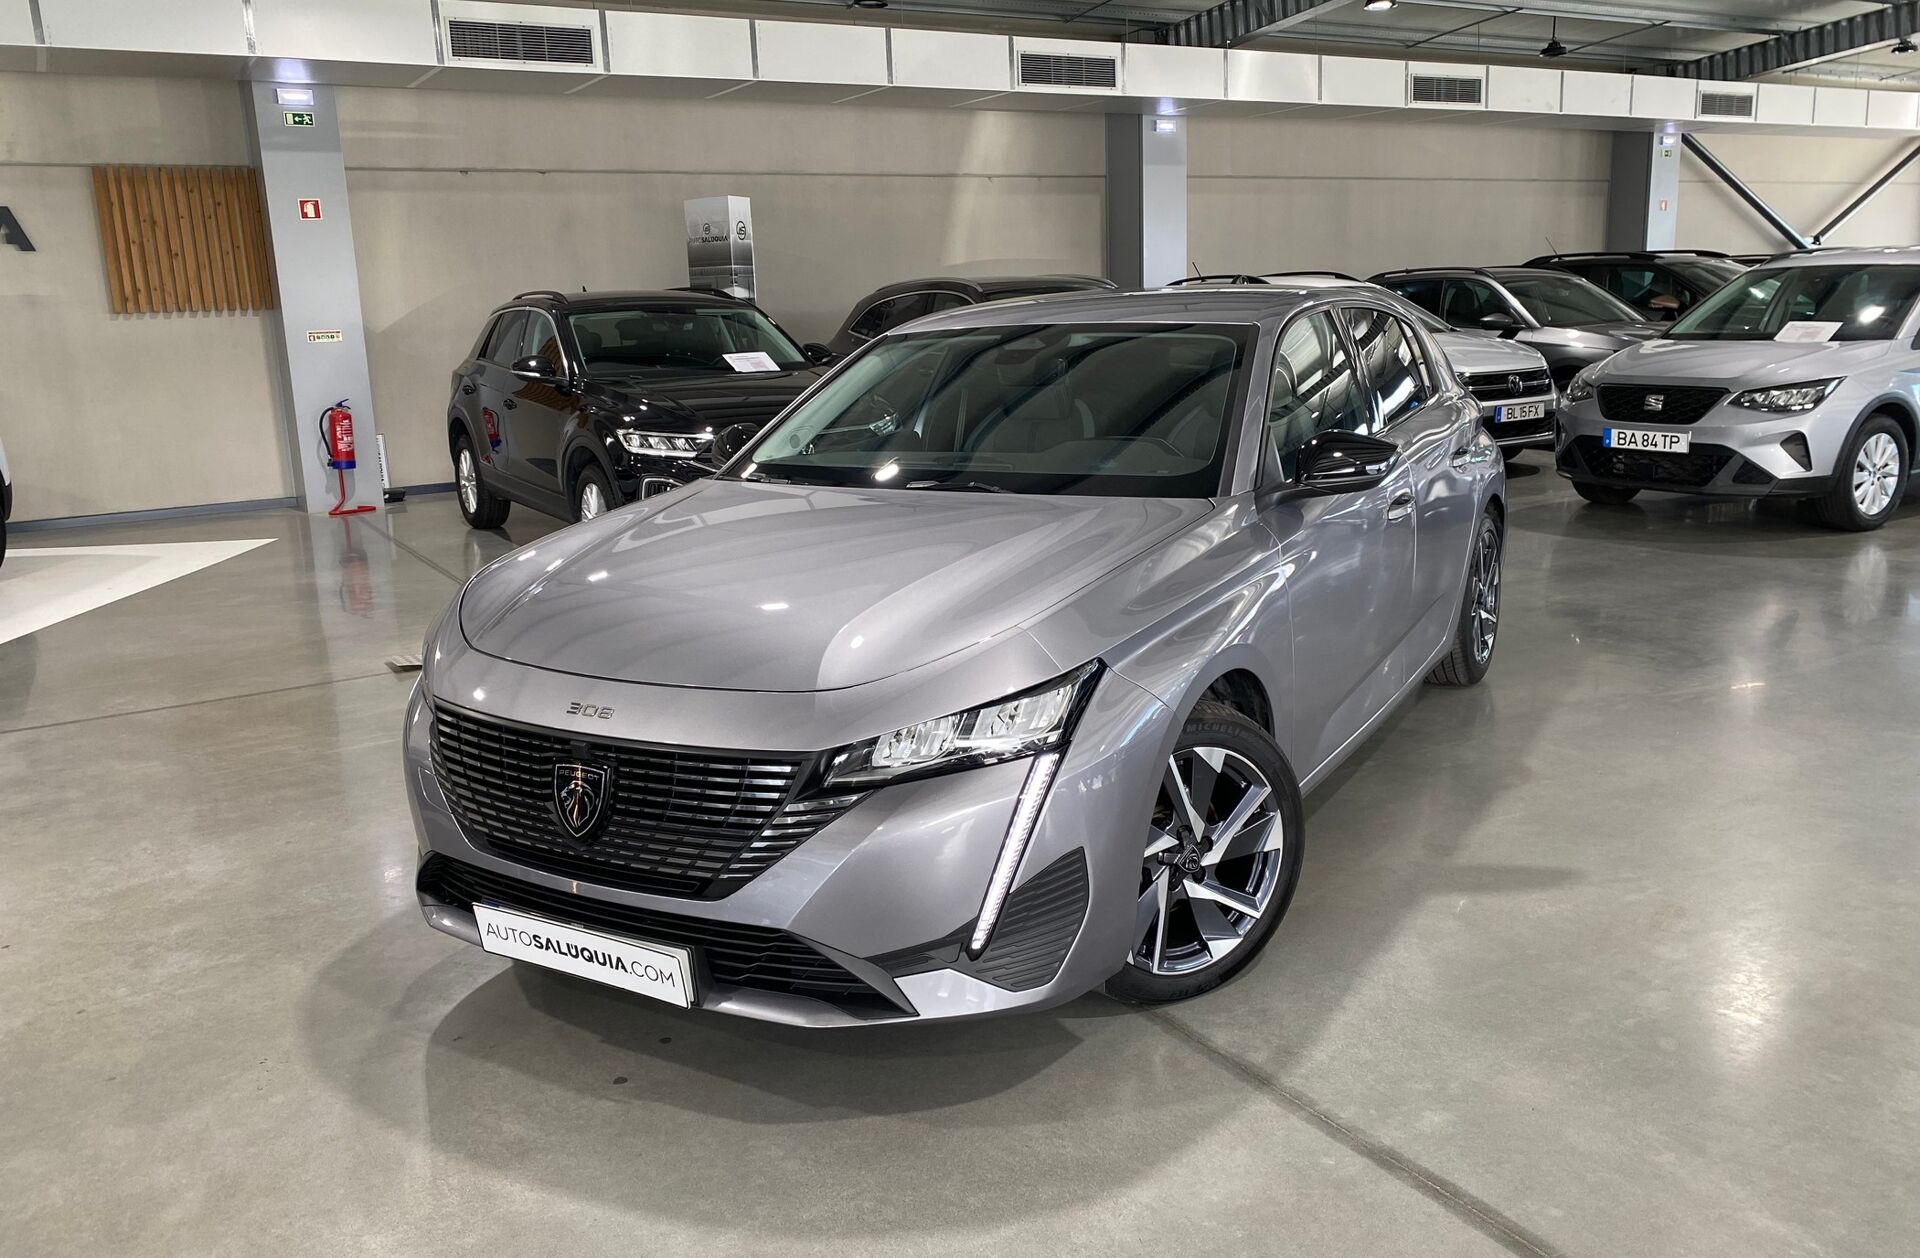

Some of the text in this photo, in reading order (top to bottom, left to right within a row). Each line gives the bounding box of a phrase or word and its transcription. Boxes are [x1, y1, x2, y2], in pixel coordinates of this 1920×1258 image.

[1617, 431, 1680, 450] BA 84 TP
[566, 702, 615, 719] 308
[558, 769, 599, 781] PEUGEOT
